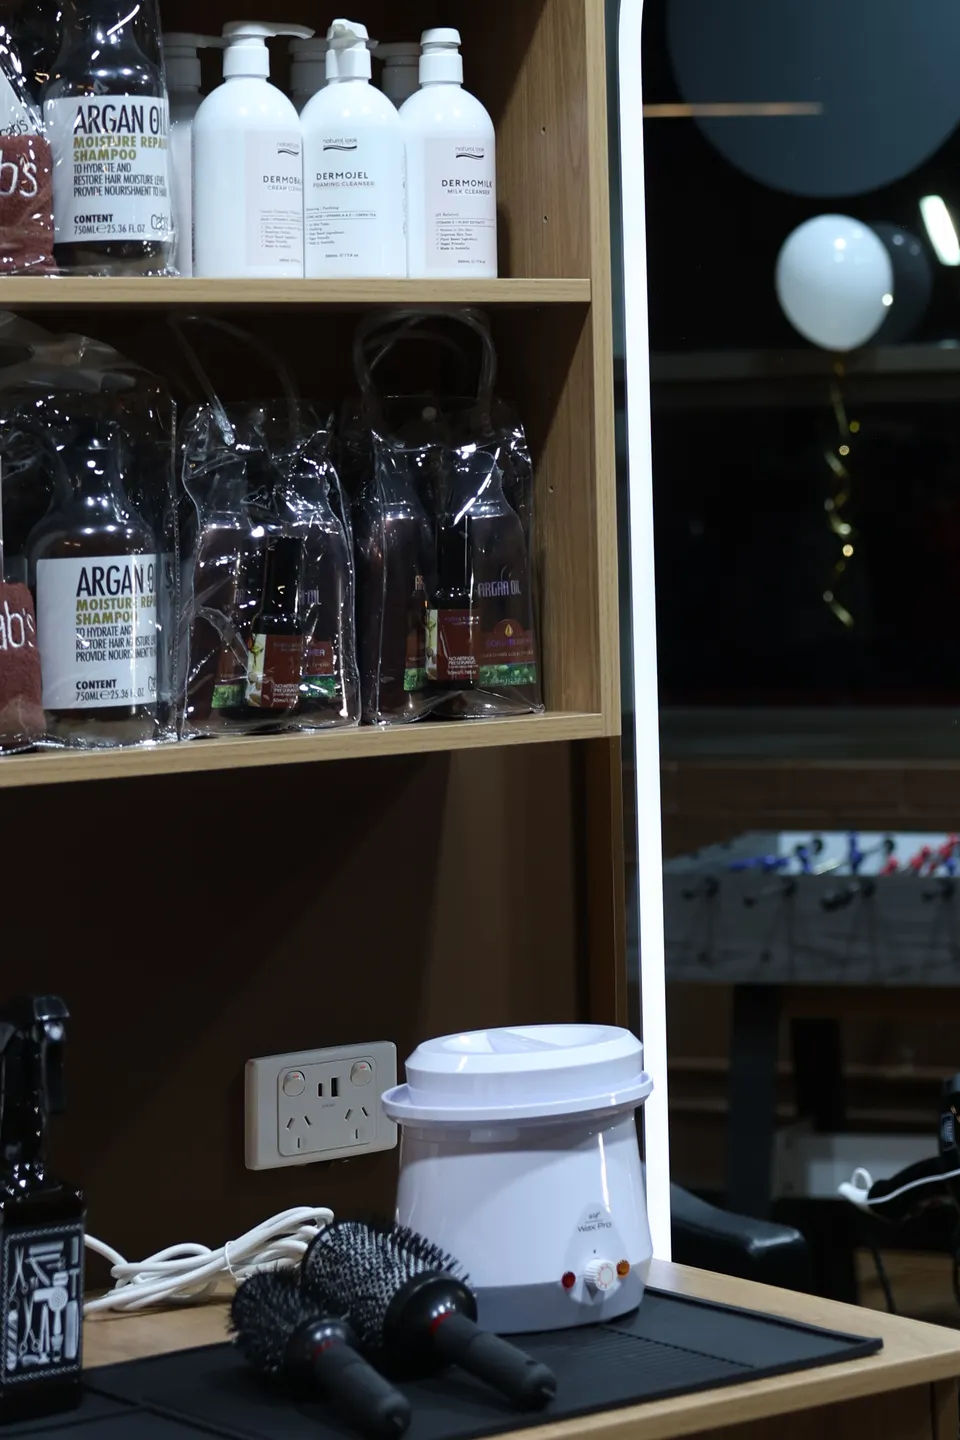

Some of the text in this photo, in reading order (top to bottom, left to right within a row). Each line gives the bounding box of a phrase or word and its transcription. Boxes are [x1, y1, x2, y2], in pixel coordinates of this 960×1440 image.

[73, 103, 144, 135] ARGAN
[73, 136, 137, 149] MOISTURE
[73, 149, 137, 162] SHAMPOO
[116, 162, 132, 173] AND
[73, 174, 103, 186] RESTORE
[104, 174, 122, 185] HAIR
[123, 175, 153, 186] MOISTURE
[316, 171, 369, 181] DERMOJEL
[441, 179, 493, 188] DERMOMILK
[73, 186, 102, 197] PROVIDE
[104, 185, 152, 197] NOURISHMENT
[73, 214, 114, 224] CONTENT
[76, 563, 144, 597] ARGAN
[86, 626, 118, 637] HYDRATE
[108, 638, 125, 649] HAIR
[76, 650, 106, 662] PROVIDE
[76, 679, 117, 690] CONTENT
